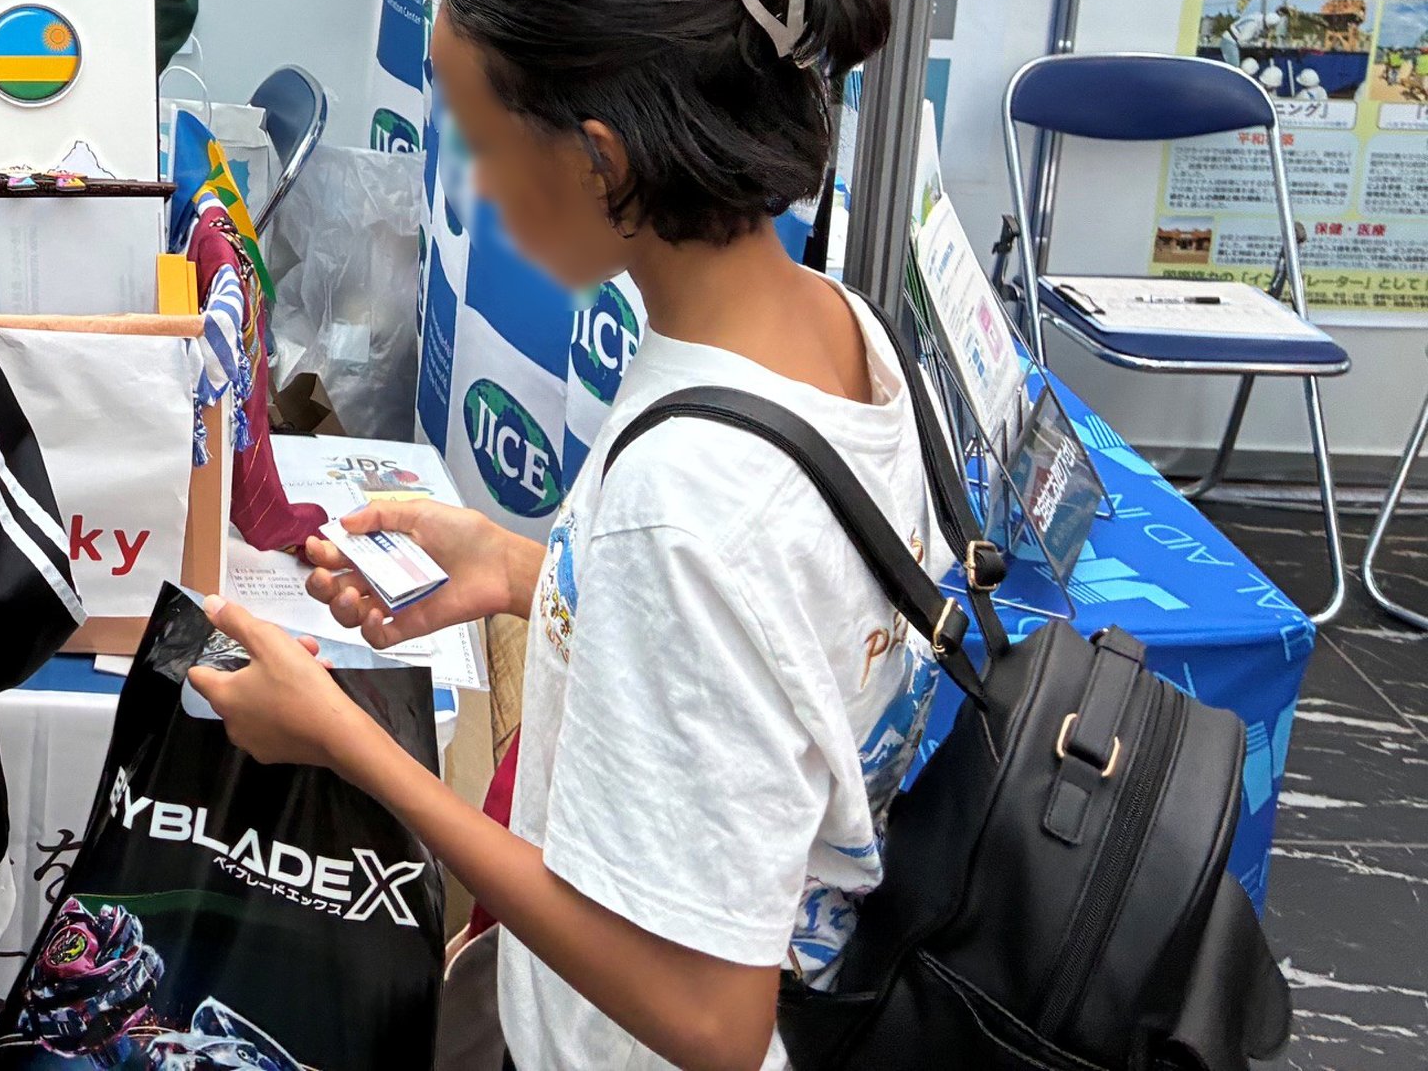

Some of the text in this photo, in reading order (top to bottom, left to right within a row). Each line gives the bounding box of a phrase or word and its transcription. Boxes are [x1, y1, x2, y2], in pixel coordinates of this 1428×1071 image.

[1236, 132, 1295, 146] 平和築
[474, 395, 549, 500] JICE
[69, 515, 151, 576] ky
[212, 855, 344, 916] ベイブレードエックス
